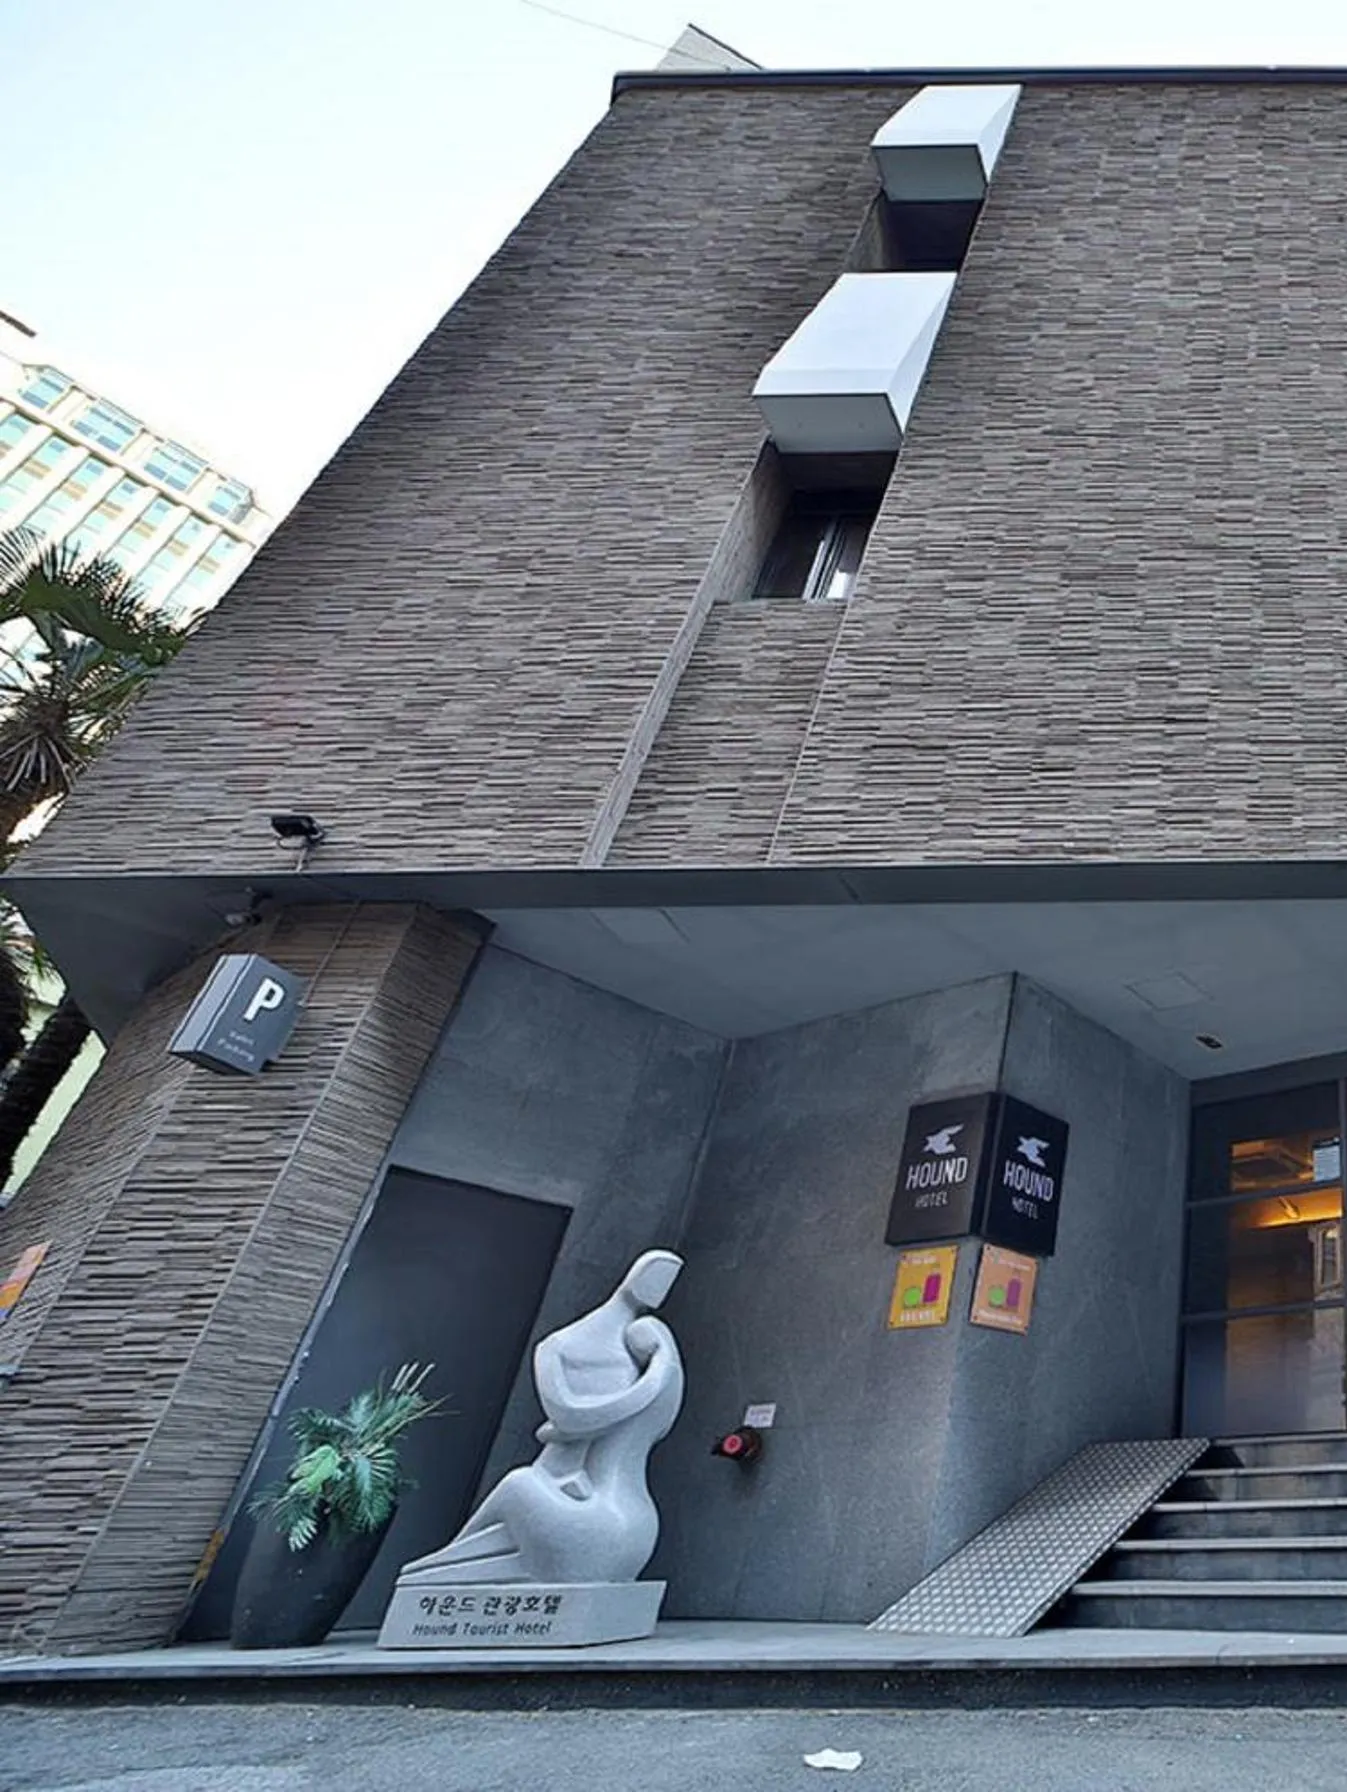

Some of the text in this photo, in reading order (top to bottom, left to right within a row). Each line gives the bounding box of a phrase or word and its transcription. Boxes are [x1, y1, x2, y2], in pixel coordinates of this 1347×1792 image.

[243, 977, 285, 1021] P
[905, 1157, 969, 1190] HOUND
[1003, 1160, 1054, 1202] HOUND
[413, 1620, 552, 1636] Hound Tourist Hotel
